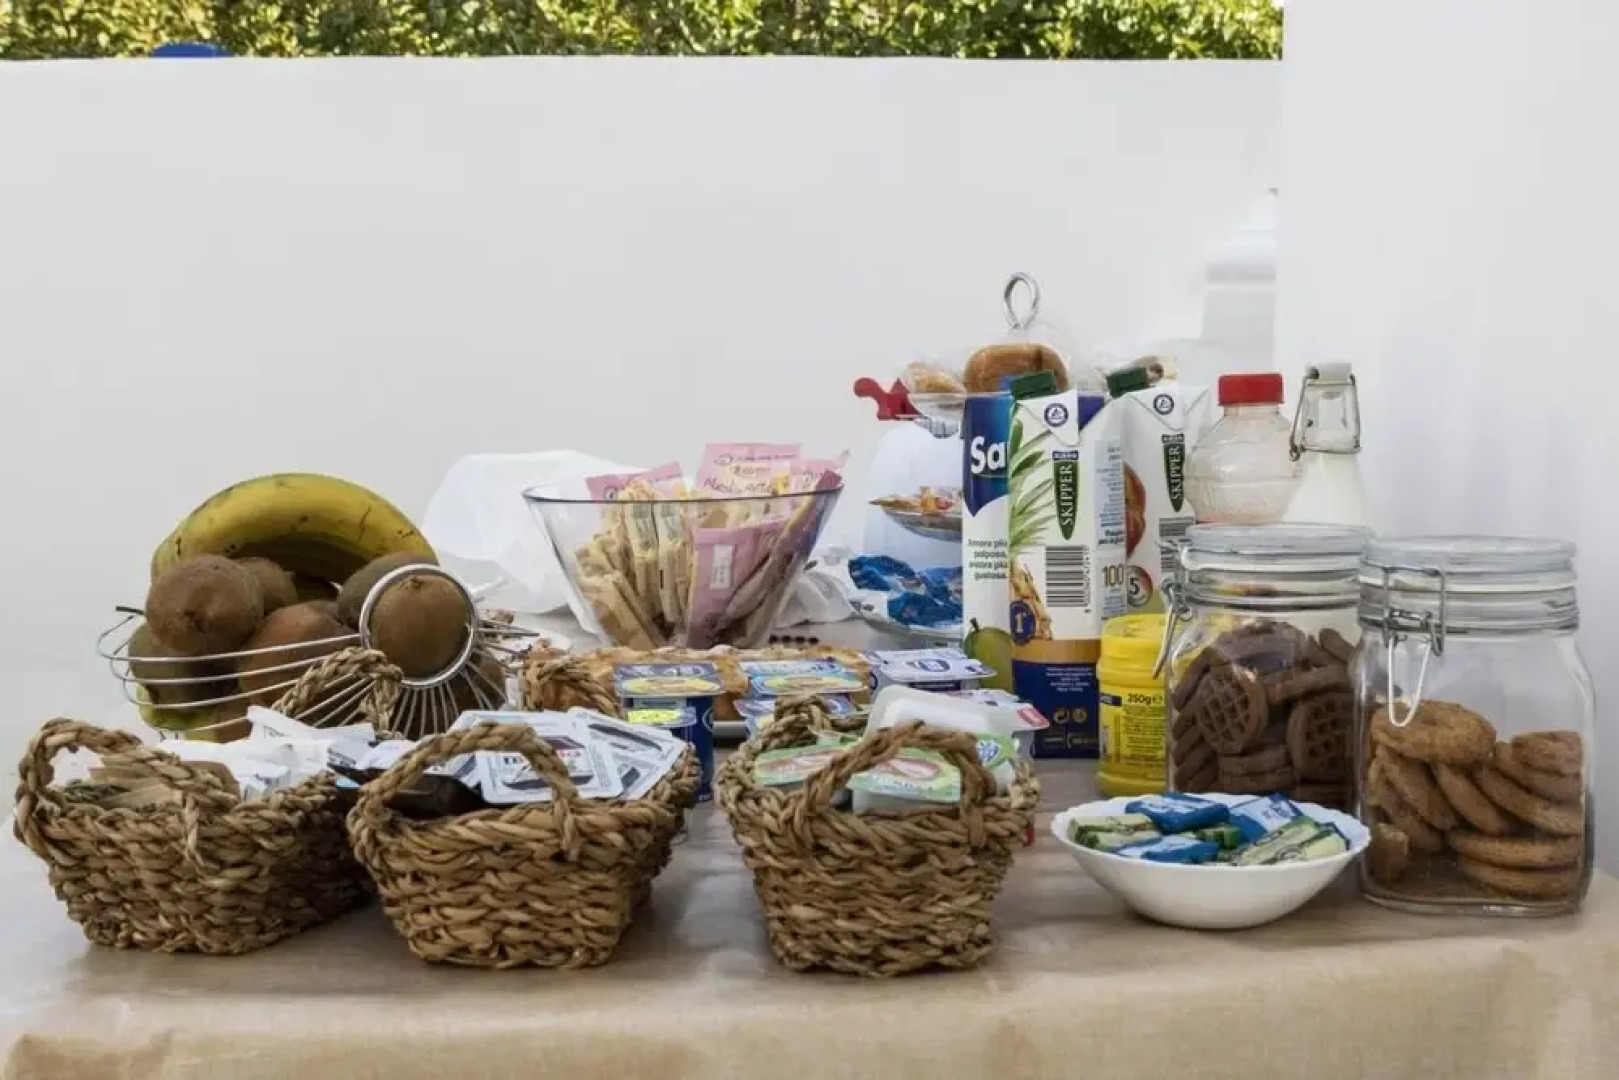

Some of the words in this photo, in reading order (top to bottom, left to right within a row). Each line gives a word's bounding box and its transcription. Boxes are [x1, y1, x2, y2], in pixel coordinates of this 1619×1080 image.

[970, 435, 1006, 474] Sa
[1168, 446, 1183, 500] SKIPPER
[1060, 464, 1074, 526] SKIPPER
